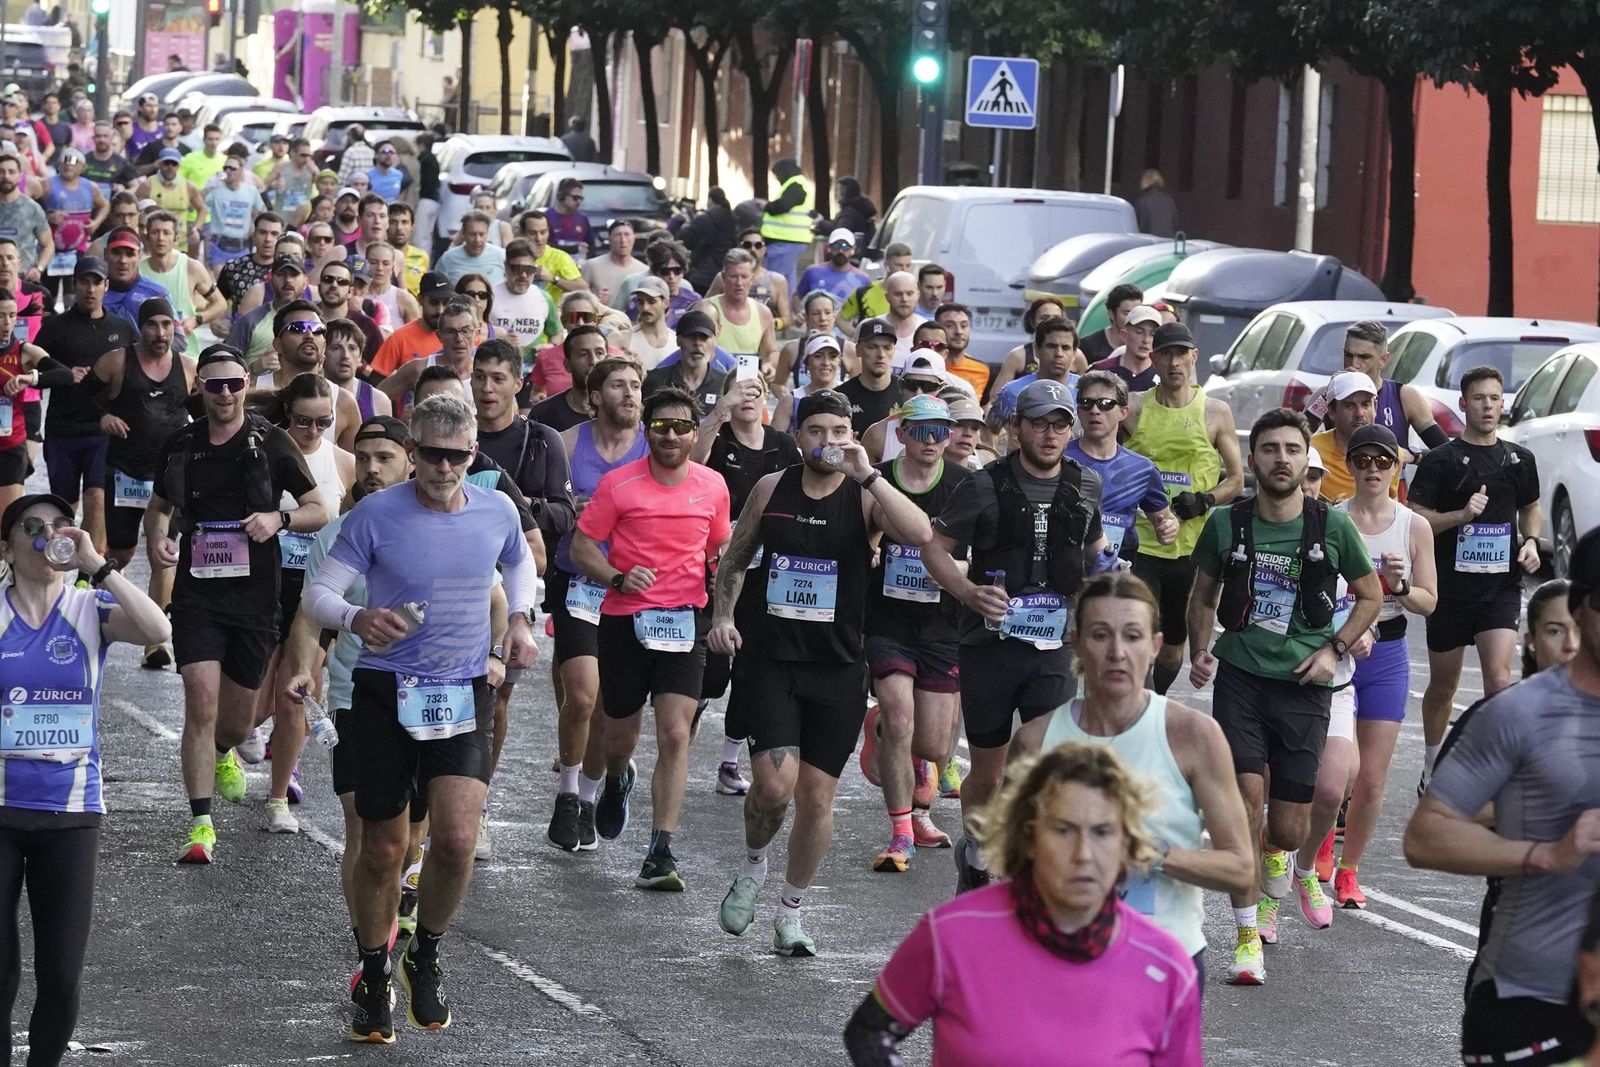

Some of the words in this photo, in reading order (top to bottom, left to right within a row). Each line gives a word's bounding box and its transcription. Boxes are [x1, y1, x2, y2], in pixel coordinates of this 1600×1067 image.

[1477, 526, 1506, 535] ZURICH
[206, 541, 228, 550] 10883
[203, 552, 232, 564] YANN
[287, 553, 308, 565] ZOË
[1462, 550, 1505, 562] CAMILLE
[794, 560, 831, 571] ZURICH
[905, 564, 922, 574] 7030
[793, 579, 813, 589] 7274
[896, 574, 929, 589] EDDIE
[1254, 570, 1290, 589] ZURICH
[785, 590, 817, 606] LIAM
[1027, 597, 1060, 606] ZURICH
[567, 599, 597, 613] MARTINEZ
[656, 615, 674, 625] 8496
[1027, 614, 1045, 622] 8708
[644, 626, 685, 639] MICHEL
[1009, 625, 1055, 638] ARTHUR
[33, 690, 82, 701] ZURICH
[426, 694, 448, 704] 7328
[33, 713, 59, 725] 8780
[421, 707, 453, 723] RICO
[15, 729, 79, 747] ZOUZOU
